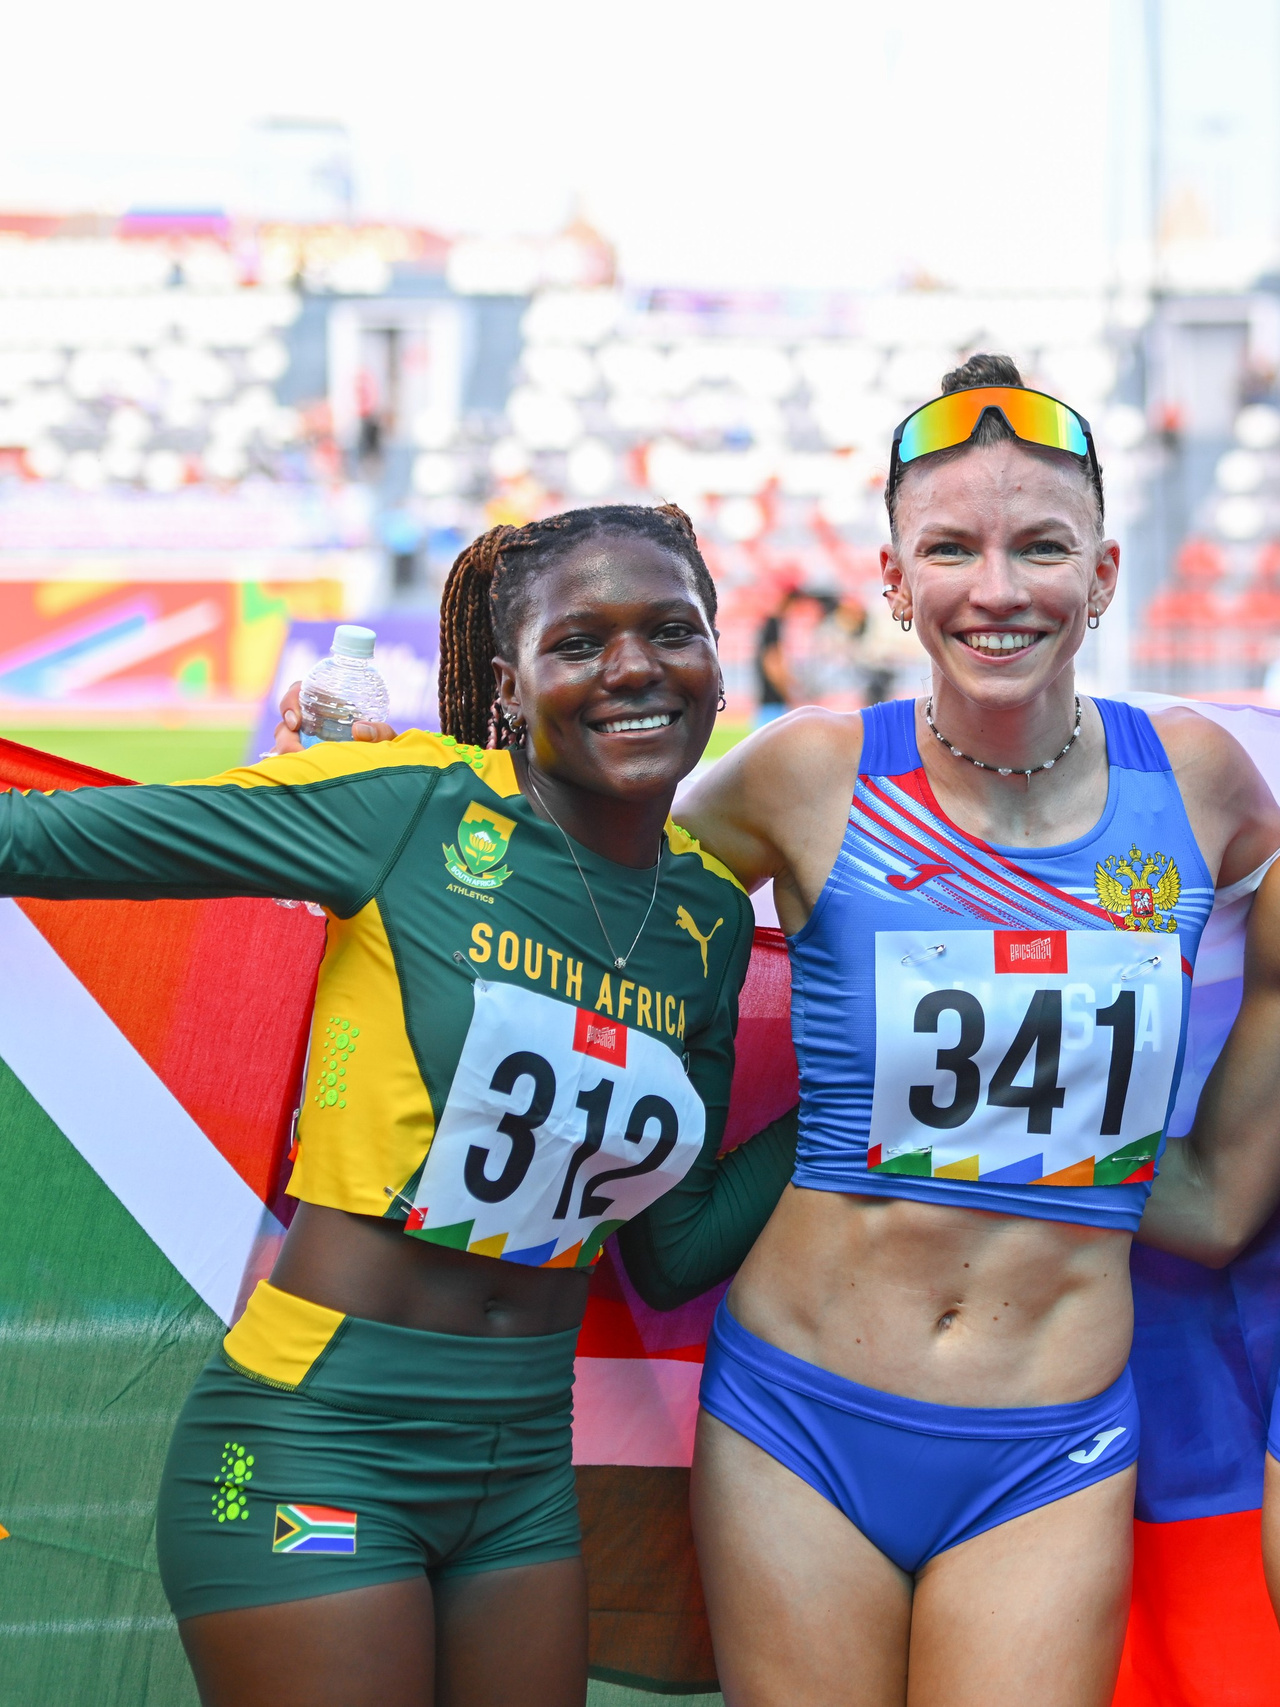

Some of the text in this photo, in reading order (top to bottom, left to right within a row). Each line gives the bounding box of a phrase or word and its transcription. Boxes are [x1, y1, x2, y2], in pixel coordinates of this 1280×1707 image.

[446, 884, 494, 904] ATHLETICS
[451, 865, 472, 883] SOUTH
[468, 922, 686, 1041] SOUTH AFRICA
[908, 988, 1136, 1136] 341
[463, 1050, 679, 1220] 312
